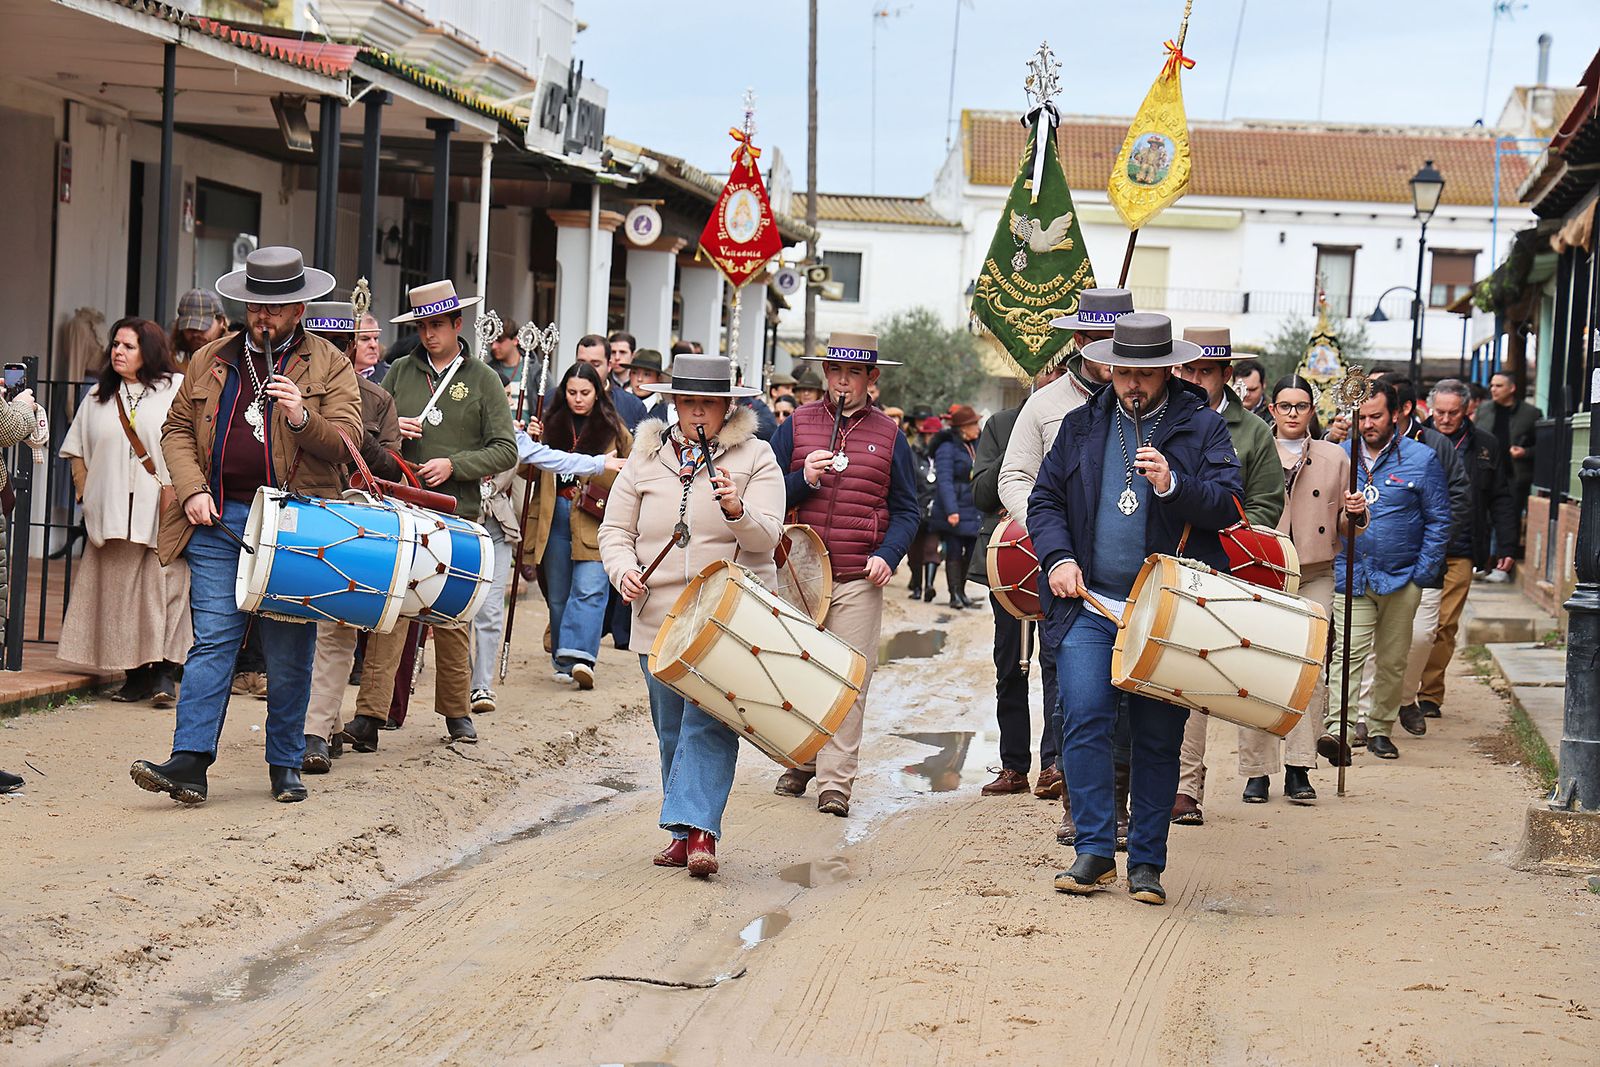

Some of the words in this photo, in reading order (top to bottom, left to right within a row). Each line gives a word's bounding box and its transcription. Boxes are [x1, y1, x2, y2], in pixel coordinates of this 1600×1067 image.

[719, 245, 761, 258] Valladolid
[986, 258, 1023, 301] HERMANDAD
[1061, 280, 1075, 294] DEL
[1011, 272, 1037, 293] GRUPO
[1038, 273, 1065, 294] JOVEN
[1080, 311, 1132, 323] VALLADO
[1203, 346, 1226, 356] OLID
